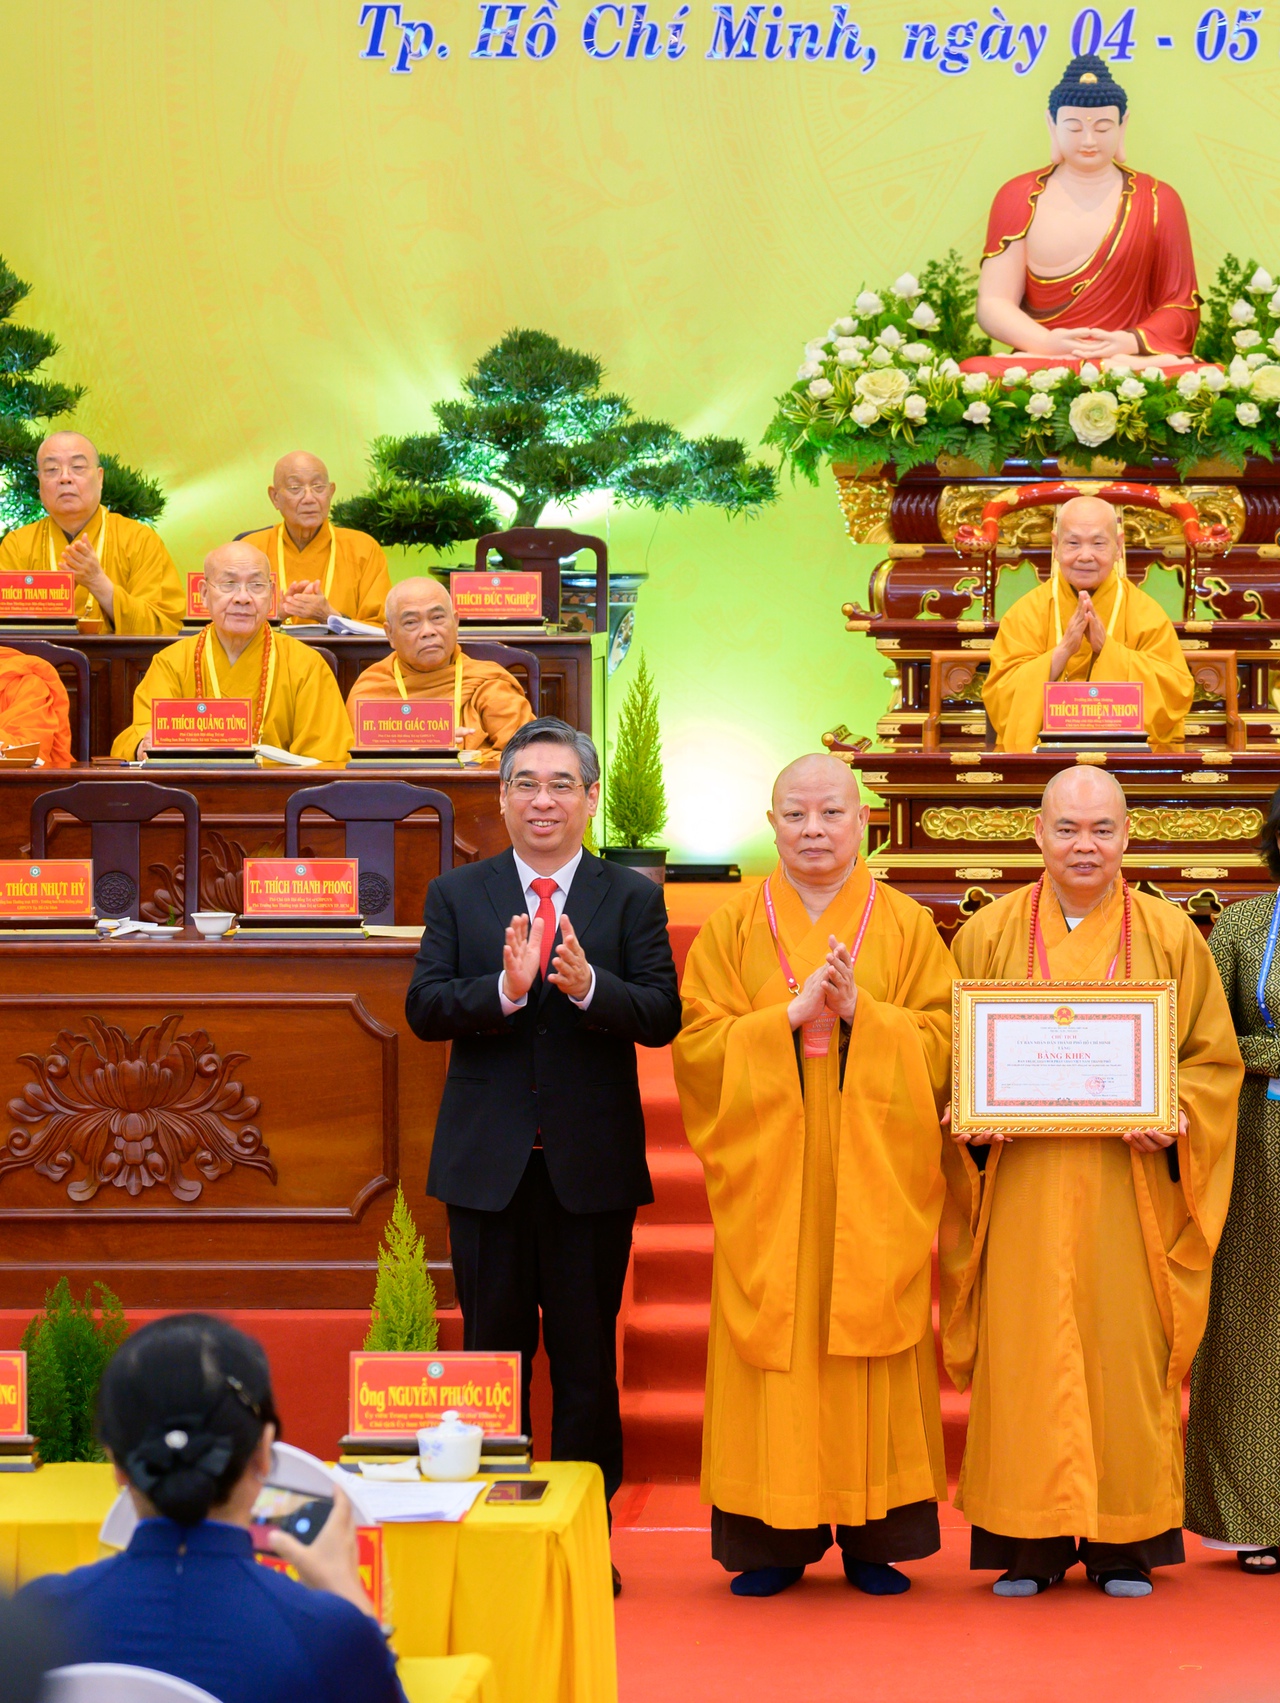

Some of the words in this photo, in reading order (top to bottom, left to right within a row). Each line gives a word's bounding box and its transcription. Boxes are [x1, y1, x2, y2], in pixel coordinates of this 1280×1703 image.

[358, 4, 450, 72] Tp.
[470, 0, 560, 59] Hồ
[580, 3, 689, 59] Chí
[704, 3, 875, 70] Minh,
[900, 8, 1047, 73] ngày
[1069, 8, 1136, 61] 04
[1156, 36, 1175, 48] -
[1196, 8, 1261, 62] 05
[1, 585, 22, 600] THÍCH
[24, 588, 47, 600] THANH
[456, 590, 482, 605] THÍCH
[484, 590, 502, 605] ĐỨC
[505, 592, 537, 608] NGHIỆP
[1049, 700, 1078, 716] THÍCH
[1082, 702, 1109, 719] THIỆN
[1112, 704, 1138, 716] NHƠN
[157, 718, 170, 730] HT.
[172, 714, 195, 730] THÍCH
[197, 714, 224, 732] QUẢNG
[226, 714, 246, 730] TÙNG
[363, 720, 376, 730] HT.
[378, 717, 402, 730] THÍCH
[404, 717, 425, 730] GIÁC
[427, 717, 450, 730] TOÀN
[6, 878, 38, 896] THÍCH
[40, 881, 68, 900] NHỰT
[70, 878, 85, 896] HỶ
[250, 880, 262, 893] TT.
[265, 876, 290, 893] THÍCH
[292, 880, 320, 893] THANH
[323, 880, 352, 893] PHONG
[360, 1382, 385, 1412] Ông
[388, 1377, 438, 1406] NGUYỄN
[440, 1380, 482, 1406] PHƯỚC
[486, 1382, 512, 1412] LỘC
